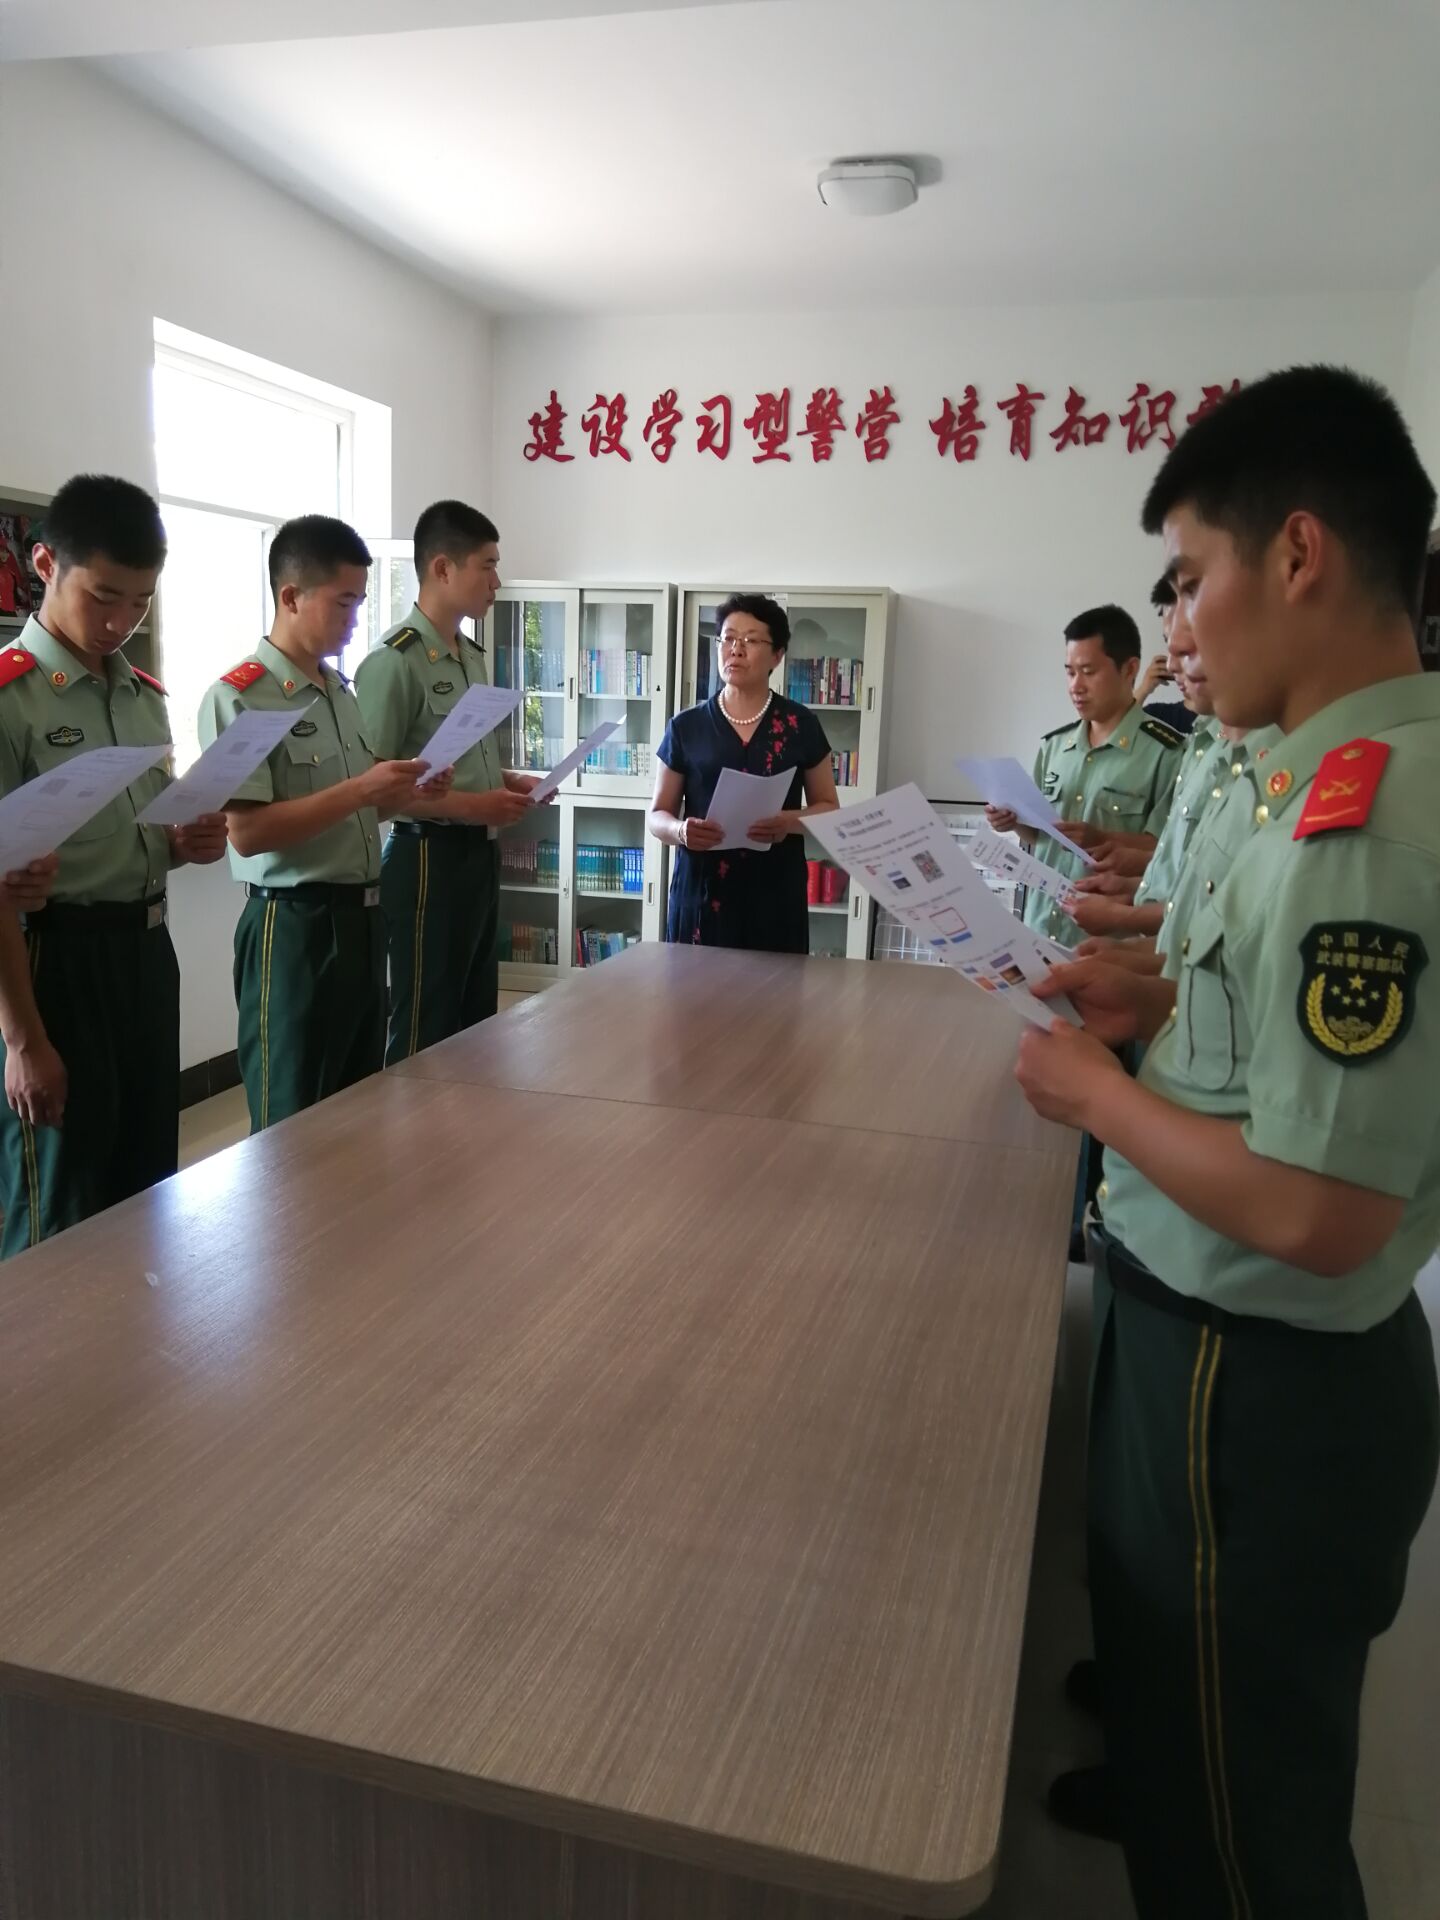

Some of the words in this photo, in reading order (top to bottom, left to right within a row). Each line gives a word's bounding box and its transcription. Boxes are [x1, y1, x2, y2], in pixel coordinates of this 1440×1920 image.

[524, 387, 901, 464] 建设学习型警营
